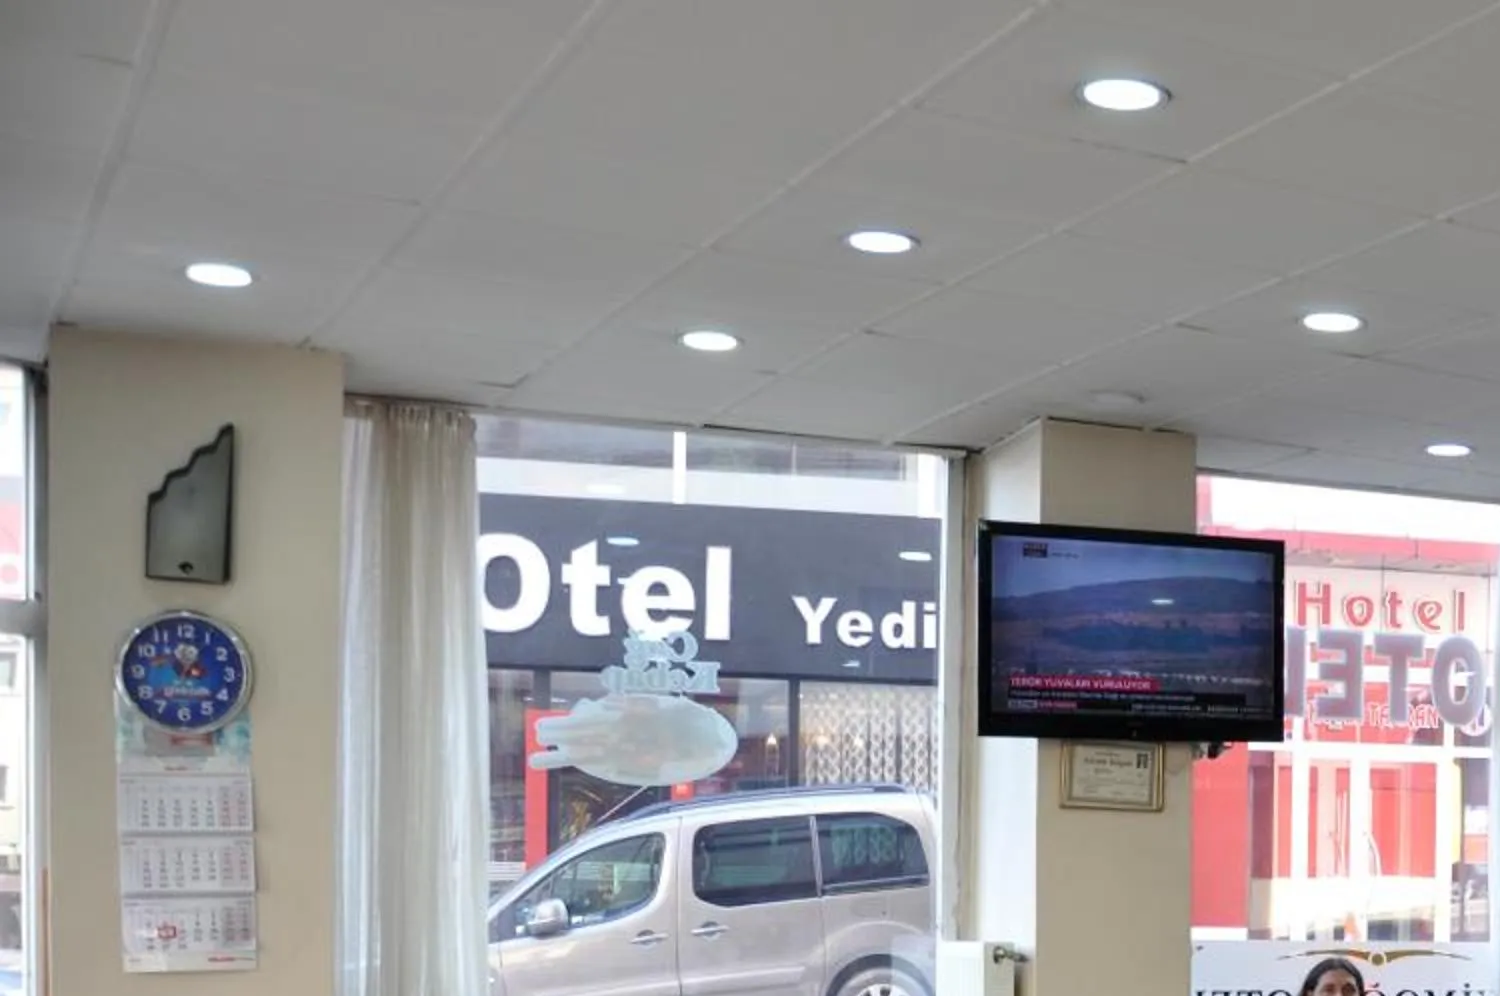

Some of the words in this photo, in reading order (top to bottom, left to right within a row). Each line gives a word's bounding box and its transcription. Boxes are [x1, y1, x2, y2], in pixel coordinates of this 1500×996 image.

[476, 533, 731, 642] Otel
[792, 596, 937, 648] Yedi
[1296, 582, 1465, 632] Hotel
[177, 624, 195, 638] 12
[138, 645, 155, 657] 10
[216, 647, 228, 661] 2
[131, 664, 145, 679] 9
[224, 667, 235, 682] 3
[138, 685, 152, 699] 8
[216, 688, 229, 700] 4
[155, 700, 167, 714] 7
[177, 707, 191, 721] 6
[201, 702, 214, 715] 5
